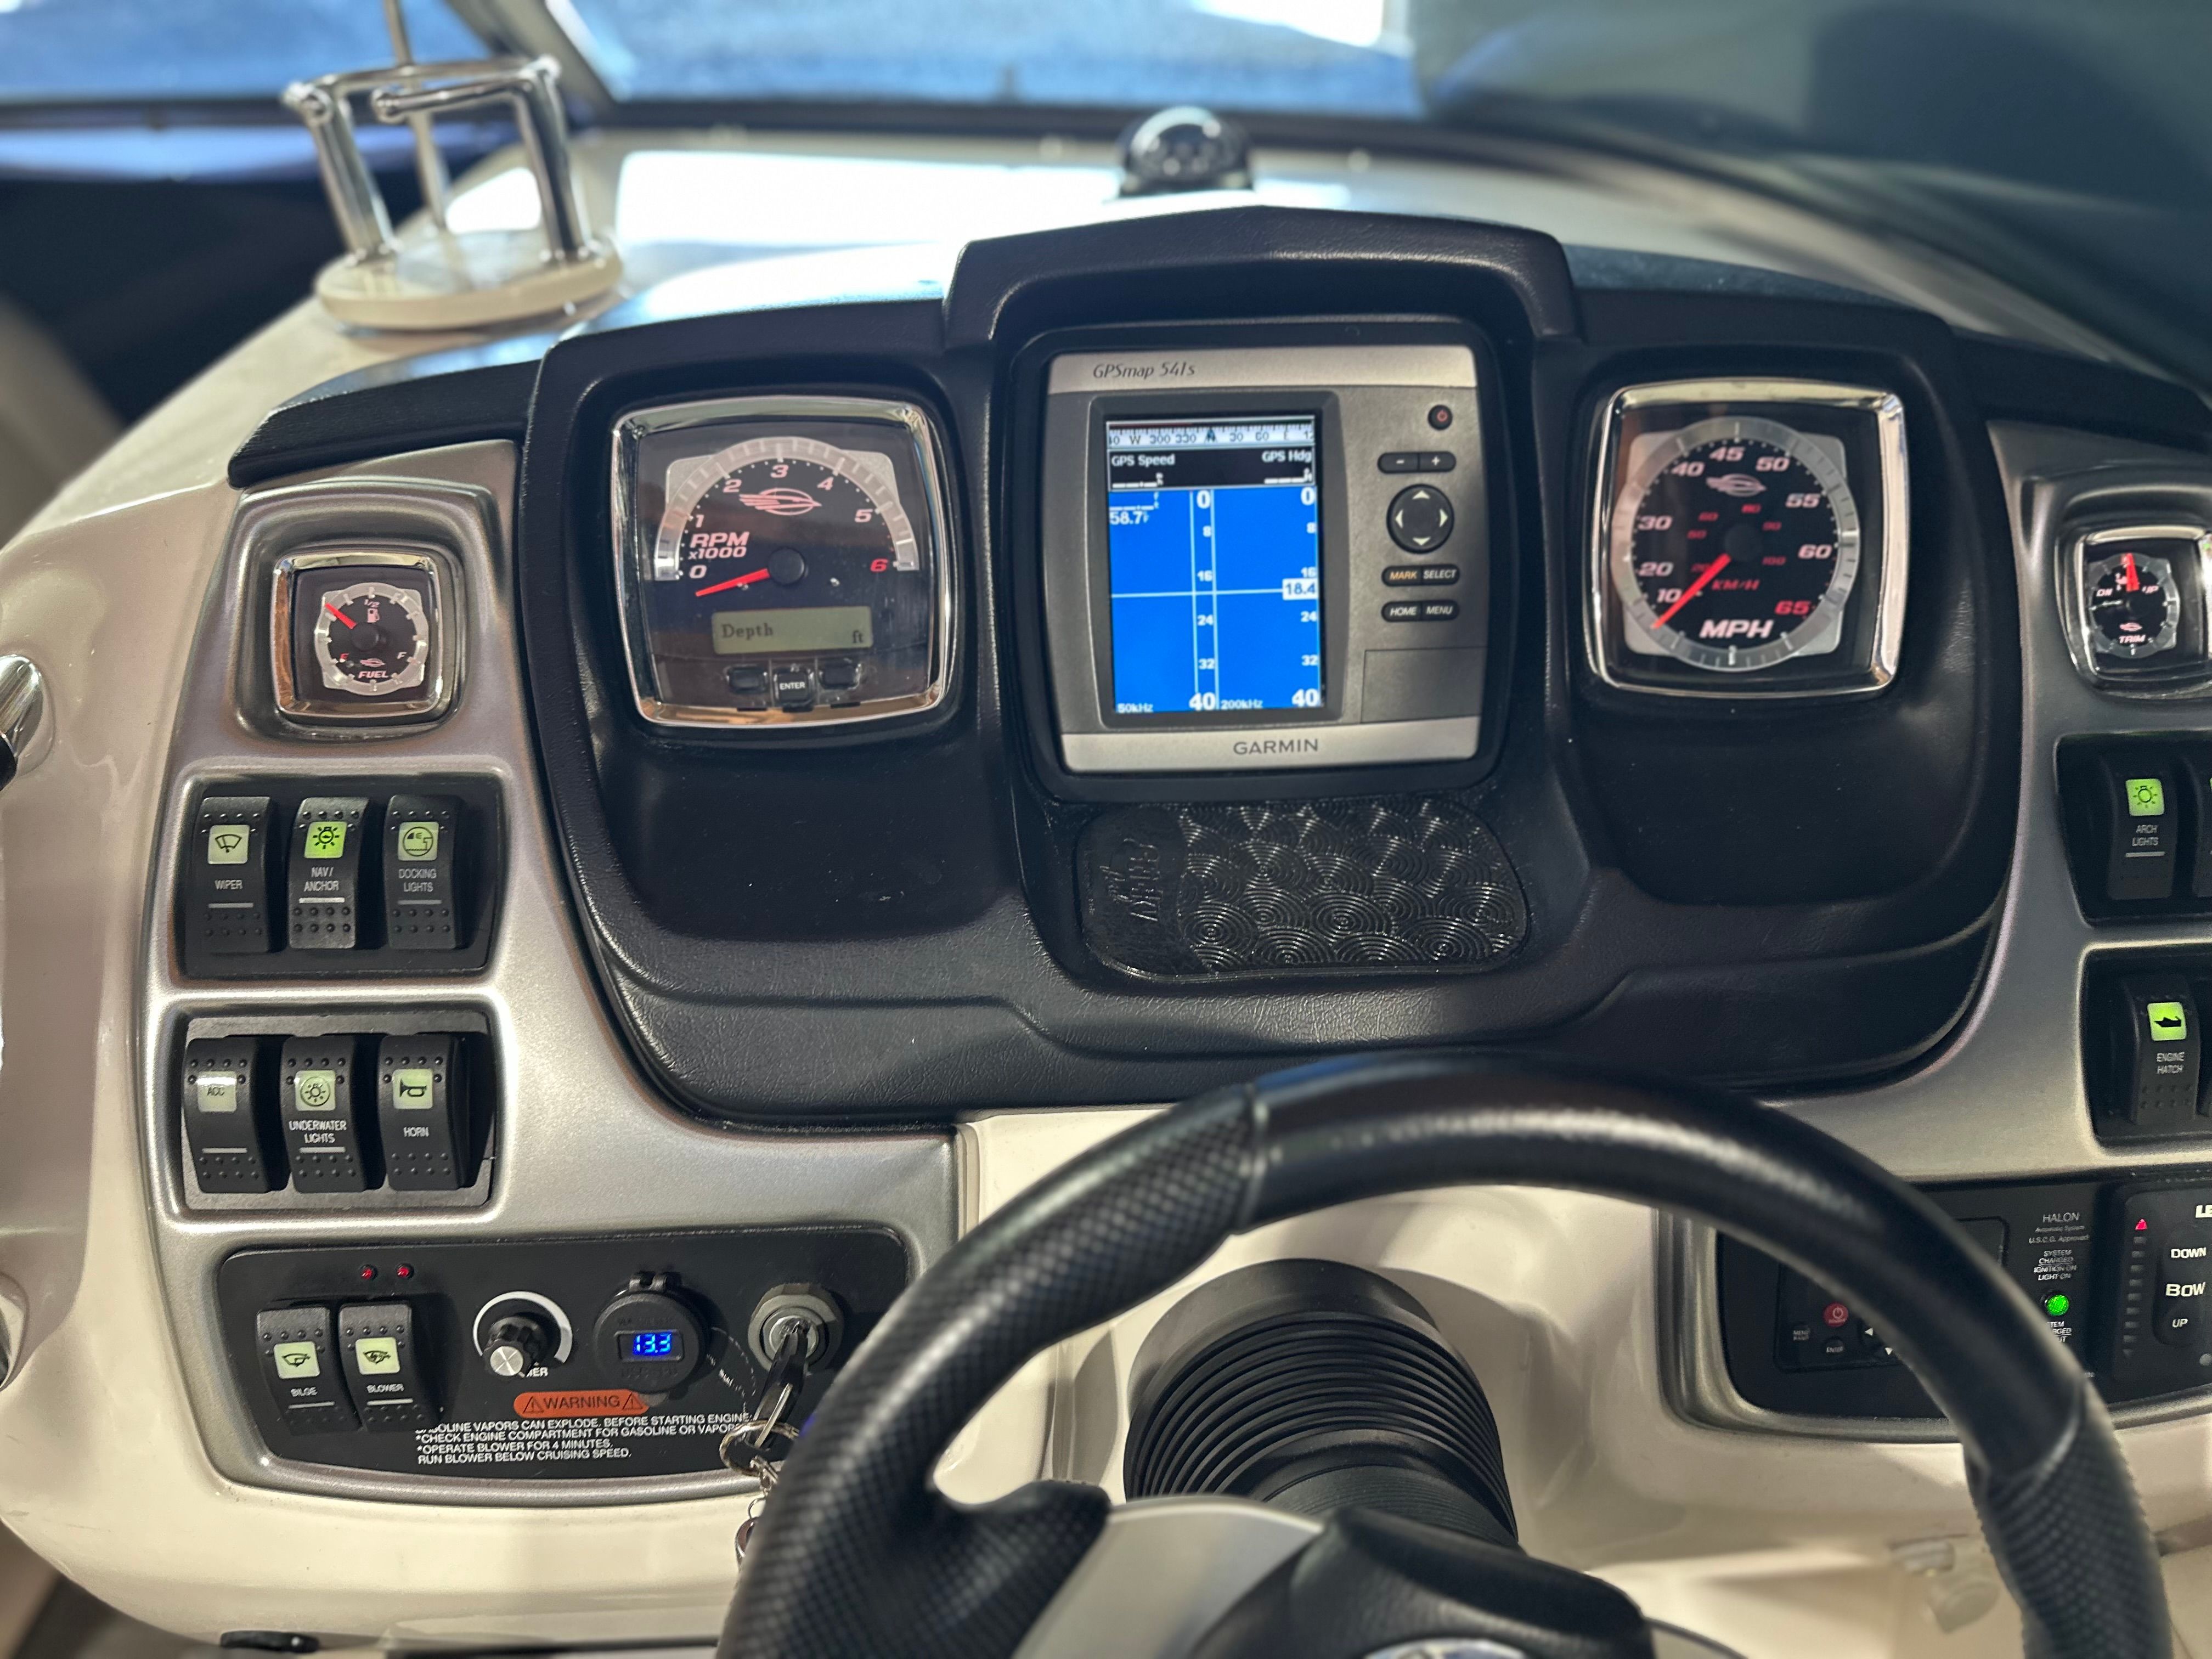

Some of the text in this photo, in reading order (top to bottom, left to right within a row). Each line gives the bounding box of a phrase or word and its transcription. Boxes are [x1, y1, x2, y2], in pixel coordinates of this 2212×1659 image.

[1093, 362, 1195, 380] GPSmap 541s
[1130, 435, 1141, 444] W
[1149, 435, 1171, 444] 300
[1229, 432, 1244, 442] 30
[1262, 449, 1312, 462] GPS Hdg
[1709, 447, 1745, 460] 45
[1111, 453, 1175, 467] GPS Speed
[1756, 458, 1790, 471] 50
[770, 465, 789, 479] 3
[1672, 462, 1705, 476] 40
[723, 479, 742, 493] 2
[817, 478, 834, 491] 4
[1197, 490, 1211, 509] 0
[1301, 487, 1316, 505] 0
[1785, 494, 1820, 507] 55
[695, 514, 705, 528] 1
[855, 509, 873, 522] 5
[1307, 522, 1316, 533] 8
[1638, 516, 1673, 530] 30
[1203, 526, 1211, 537] 8
[690, 531, 750, 549] RPM
[689, 546, 747, 560] x1000
[1798, 545, 1832, 558] 60
[871, 559, 888, 572] 6
[1639, 562, 1673, 577] 20
[689, 565, 707, 579] 0
[1198, 571, 1214, 582] 16
[1301, 567, 1317, 578] 16
[1390, 571, 1418, 580] MARK
[1424, 569, 1457, 579] SELECT
[1285, 582, 1317, 595] 18.4
[1712, 579, 1760, 590] KM/H
[1657, 589, 1683, 603] 10
[364, 599, 380, 608] 1/2
[1775, 601, 1812, 615] 65
[1301, 611, 1317, 622] 24
[1390, 607, 1417, 616] HOME
[1426, 606, 1453, 615] MENU
[1198, 614, 1214, 626] 24
[721, 623, 774, 639] Depth
[1700, 620, 1774, 638] MPH
[853, 630, 864, 644] ft
[2119, 635, 2146, 644] TRIM
[397, 651, 407, 659] F
[1302, 655, 1318, 666] 32
[1199, 659, 1215, 670] 32
[358, 670, 388, 679] FUEL
[780, 681, 805, 690] ENTER
[1189, 692, 1216, 711] 40
[1221, 699, 1263, 709] 200kHz
[1292, 689, 1319, 707] 40
[1233, 738, 1318, 755] GARMIN
[2136, 825, 2158, 834] ARCH
[2132, 837, 2159, 847] LIGHTS
[311, 866, 334, 877] NAV/
[399, 868, 437, 879] DOCKING
[215, 879, 243, 890] WIPER
[304, 880, 339, 891] ANCHOR
[403, 882, 433, 893] LIGHTS
[2157, 1052, 2185, 1063] ENGINE
[2157, 1065, 2183, 1075] HATCH
[207, 1086, 225, 1096] ACC
[289, 1120, 347, 1131] UNDERWATER
[304, 1132, 336, 1143] LIGHTS
[403, 1127, 429, 1137] HORN
[2042, 1212, 2080, 1223] HALON
[2171, 1247, 2207, 1259] DOWN
[2039, 1256, 2073, 1265] CHARGED
[2166, 1282, 2205, 1297] BOW
[2172, 1318, 2188, 1328] UP
[634, 1333, 673, 1355] 13.3
[291, 1387, 318, 1397] BILGE
[366, 1383, 404, 1393] BLOWER
[543, 1395, 619, 1409] WARNING
[473, 1420, 519, 1432] VAPORS
[521, 1419, 546, 1430] CAN
[603, 1415, 648, 1427] BEFORE
[651, 1414, 705, 1426] STARTING
[463, 1431, 506, 1442] ENGINE
[509, 1429, 592, 1440] COMPARTMENT
[596, 1427, 618, 1438] FOR
[620, 1426, 677, 1437] GASOLINE
[679, 1425, 696, 1435] OR
[477, 1442, 524, 1453] BLOWER
[527, 1441, 550, 1451] FOR
[552, 1440, 559, 1449] 4
[418, 1454, 443, 1465] RUN
[445, 1453, 493, 1464] BLOWER
[495, 1451, 535, 1463] BELOW
[537, 1449, 590, 1460] CRUISING
